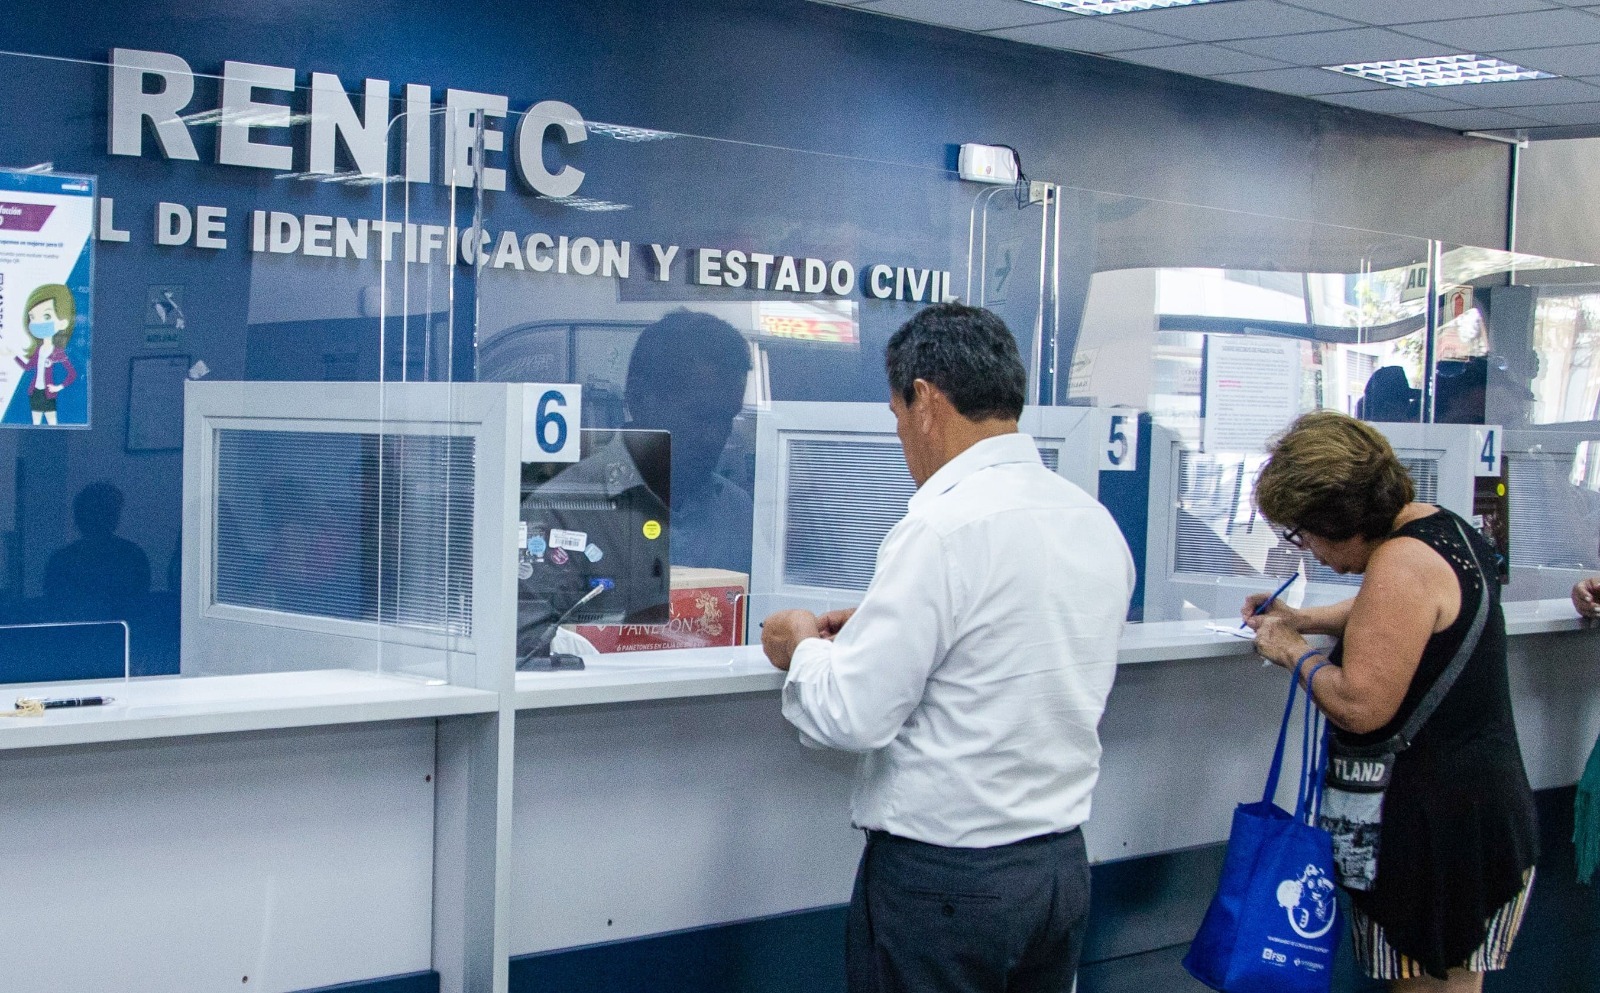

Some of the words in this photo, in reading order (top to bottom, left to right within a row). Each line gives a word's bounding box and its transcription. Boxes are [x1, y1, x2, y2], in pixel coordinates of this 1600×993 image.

[109, 48, 588, 197] RENIEC
[155, 202, 228, 249] DE
[249, 210, 630, 278] IDENTIFICACION
[653, 244, 680, 282] Y
[693, 248, 855, 296] ESTADO
[865, 263, 959, 304] CIVIL
[535, 390, 568, 454] 6
[1107, 415, 1129, 466] 5
[1480, 430, 1496, 472] 4
[616, 644, 622, 652] 6
